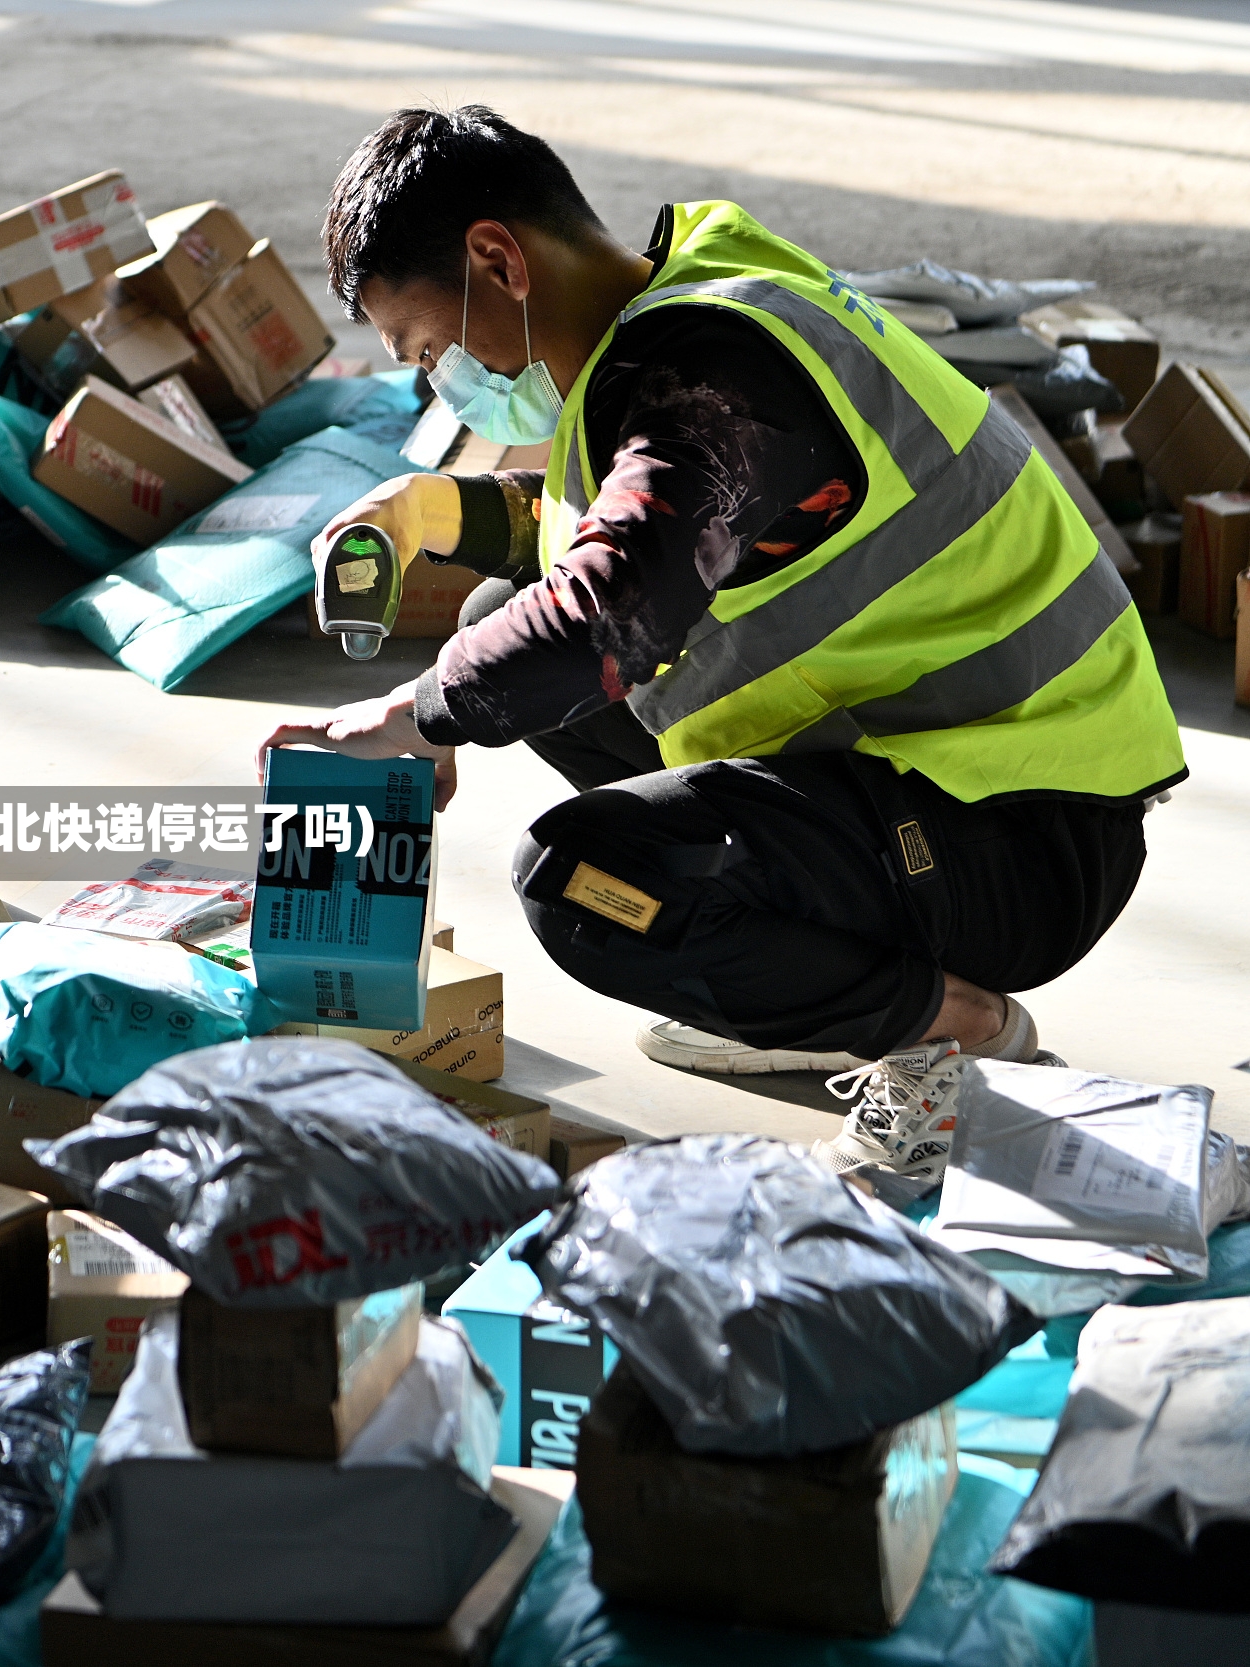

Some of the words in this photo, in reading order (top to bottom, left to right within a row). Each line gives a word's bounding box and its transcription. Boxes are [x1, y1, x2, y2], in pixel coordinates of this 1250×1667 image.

[387, 771, 400, 794] STOP
[400, 772, 414, 795] STOP
[385, 796, 399, 821] CAN'T
[269, 901, 282, 939] 现在开箱
